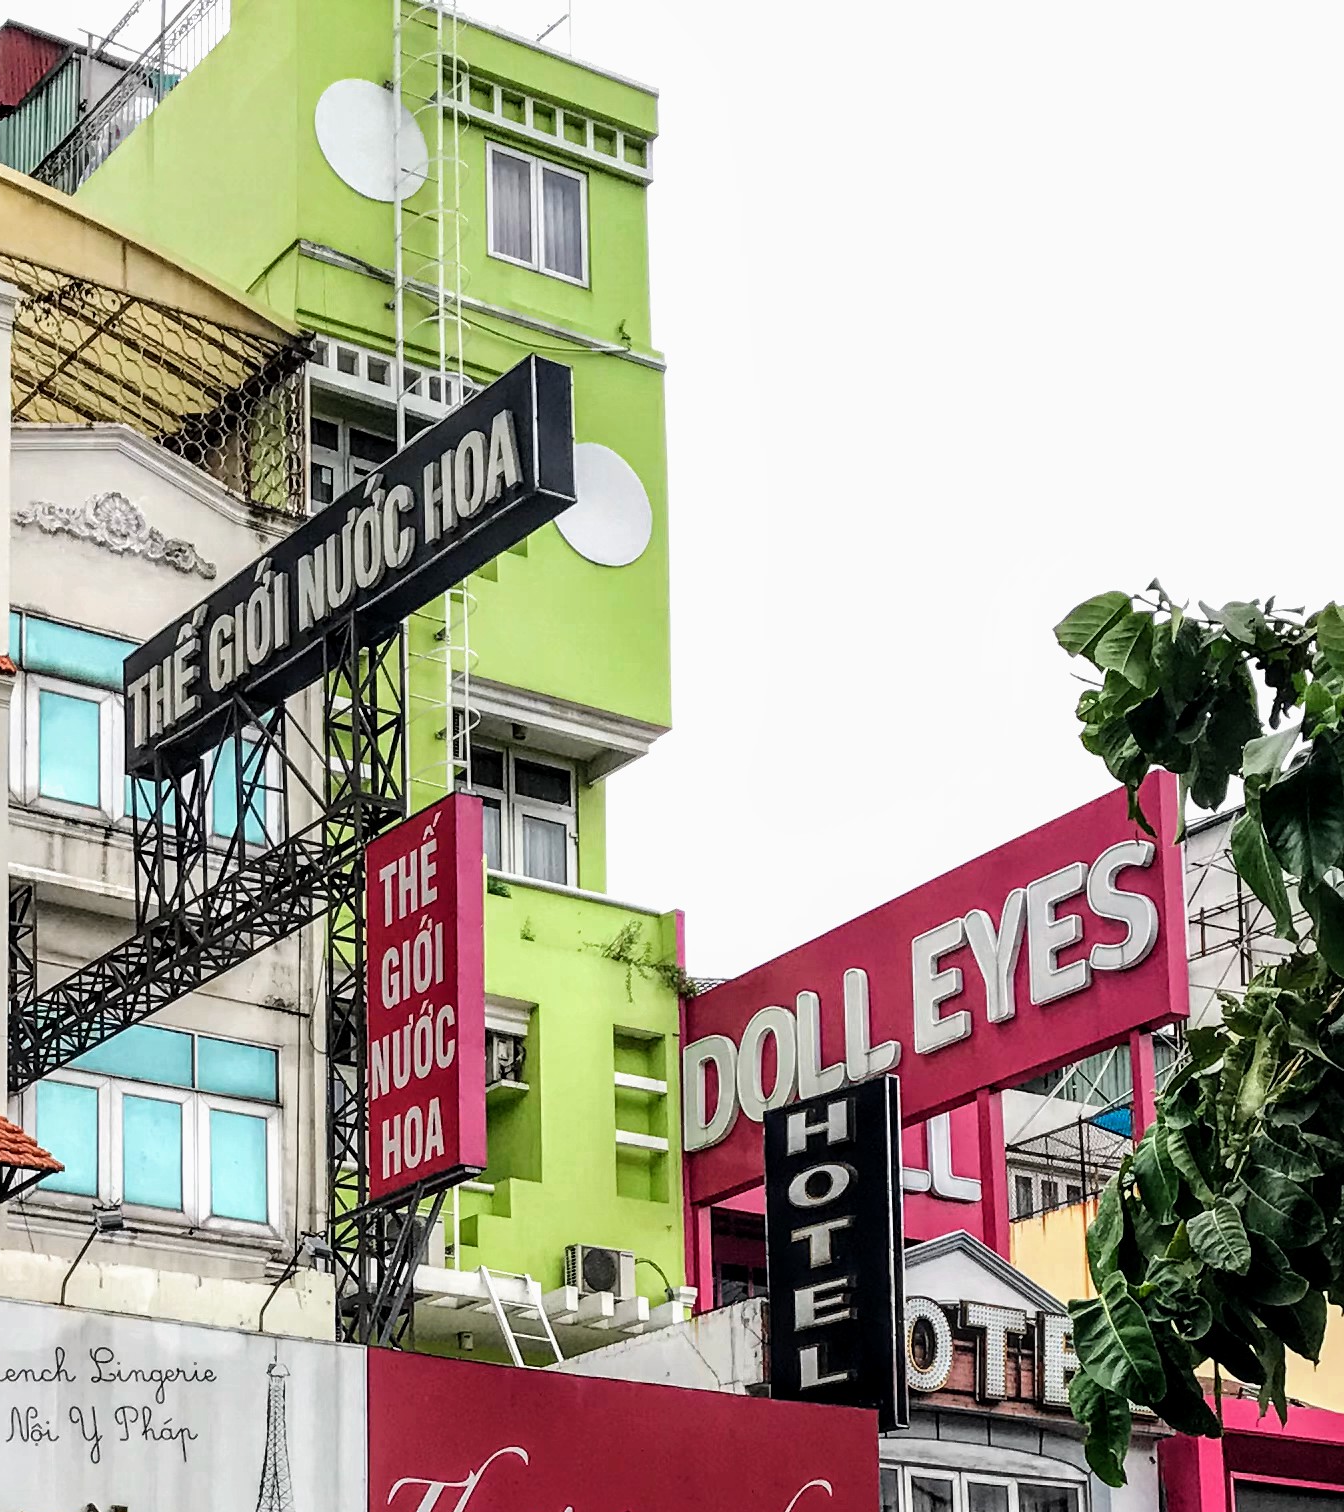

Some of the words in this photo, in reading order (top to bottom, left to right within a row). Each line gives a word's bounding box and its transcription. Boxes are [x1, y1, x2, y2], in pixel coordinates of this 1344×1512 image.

[126, 603, 209, 749] THẾ
[208, 555, 290, 694] GIỚI
[298, 472, 417, 632] NƯỚC
[423, 408, 525, 546] HOA
[379, 810, 440, 929] THẾ
[380, 908, 444, 1011] GIỚI
[683, 966, 902, 1154] DOLL
[912, 838, 1159, 1056] EYES
[370, 1003, 456, 1103] NƯỚC
[381, 1097, 445, 1180] HOA
[786, 1098, 853, 1391] HOTEL
[89, 1346, 218, 1401] Lingerie
[5, 1406, 60, 1447] Nội
[70, 1407, 104, 1464] Y
[114, 1406, 199, 1462] Pháp
